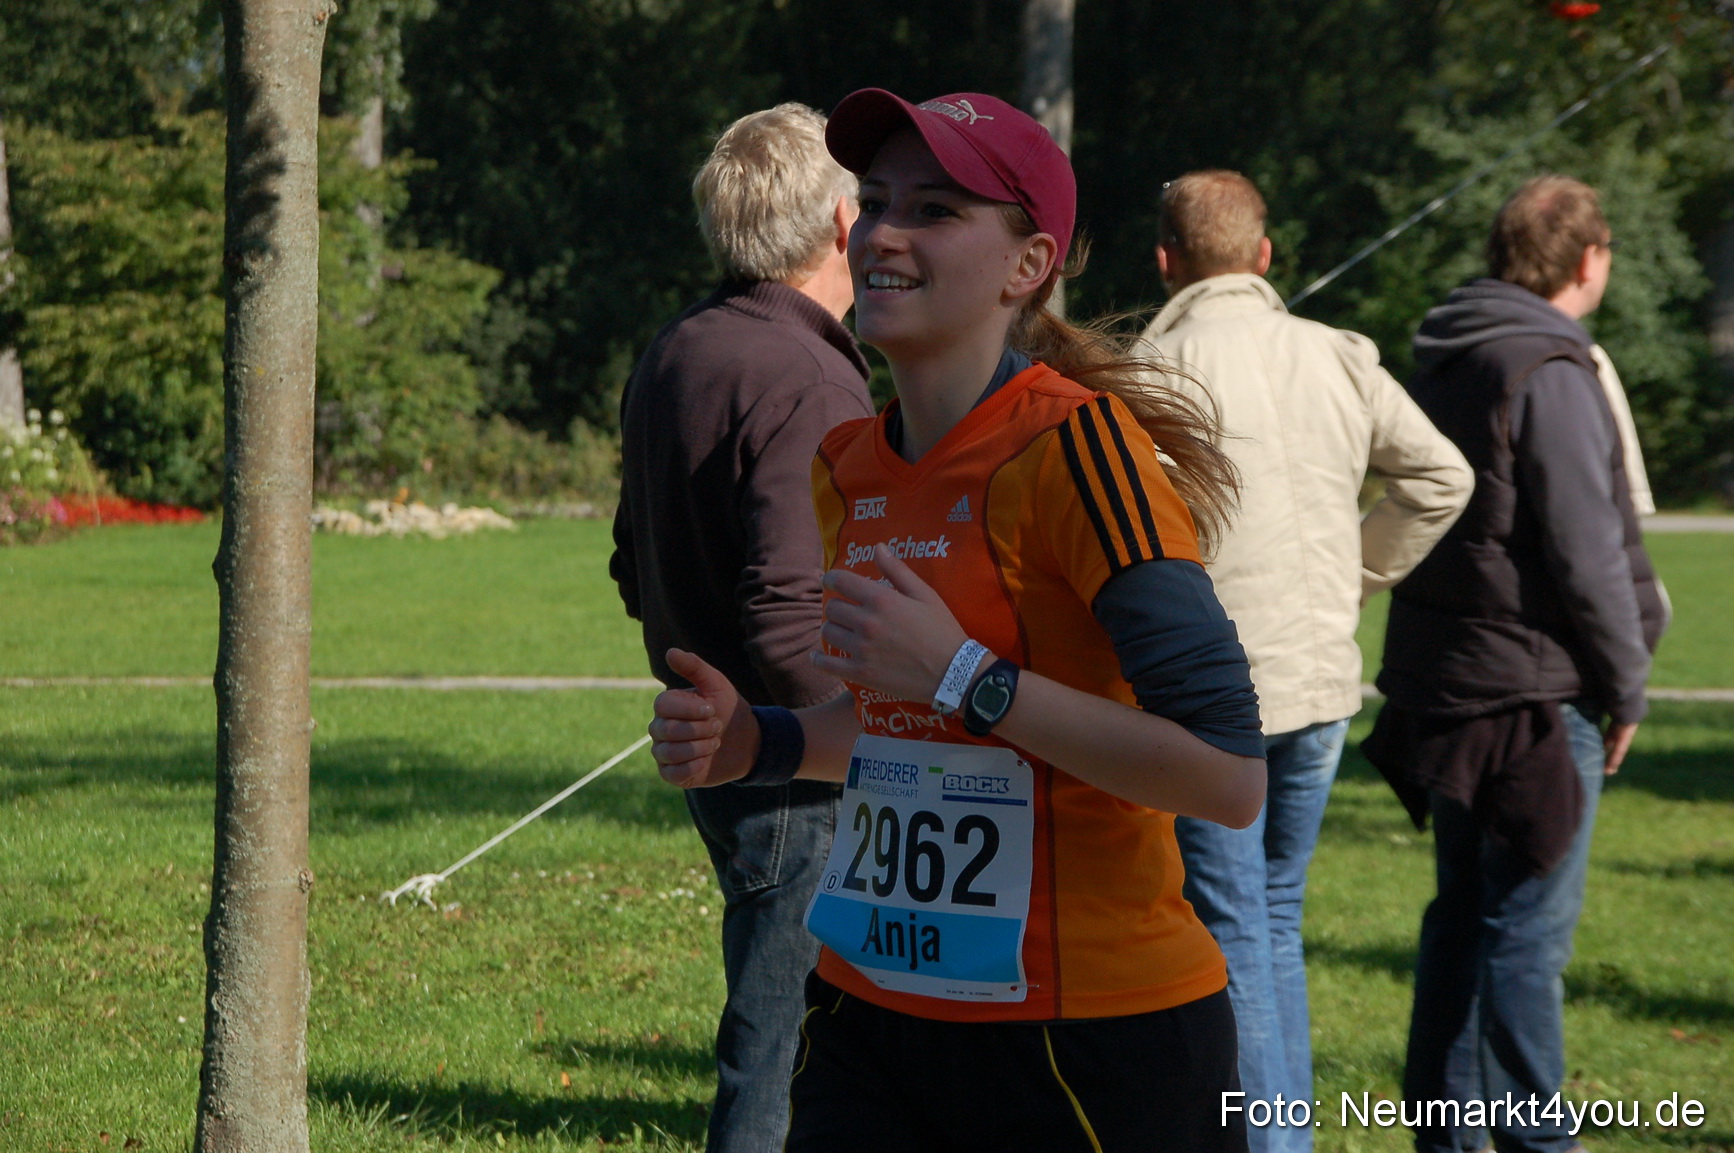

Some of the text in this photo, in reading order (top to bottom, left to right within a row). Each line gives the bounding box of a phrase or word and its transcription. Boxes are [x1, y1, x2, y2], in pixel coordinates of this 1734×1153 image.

[854, 497, 887, 520] DAK
[946, 512, 973, 523] adidas
[845, 535, 951, 568] SporScheck
[860, 758, 919, 785] PFLEIDERER
[942, 774, 1010, 794] BOCK
[842, 802, 1000, 907] 2962
[860, 907, 941, 971] Anja
